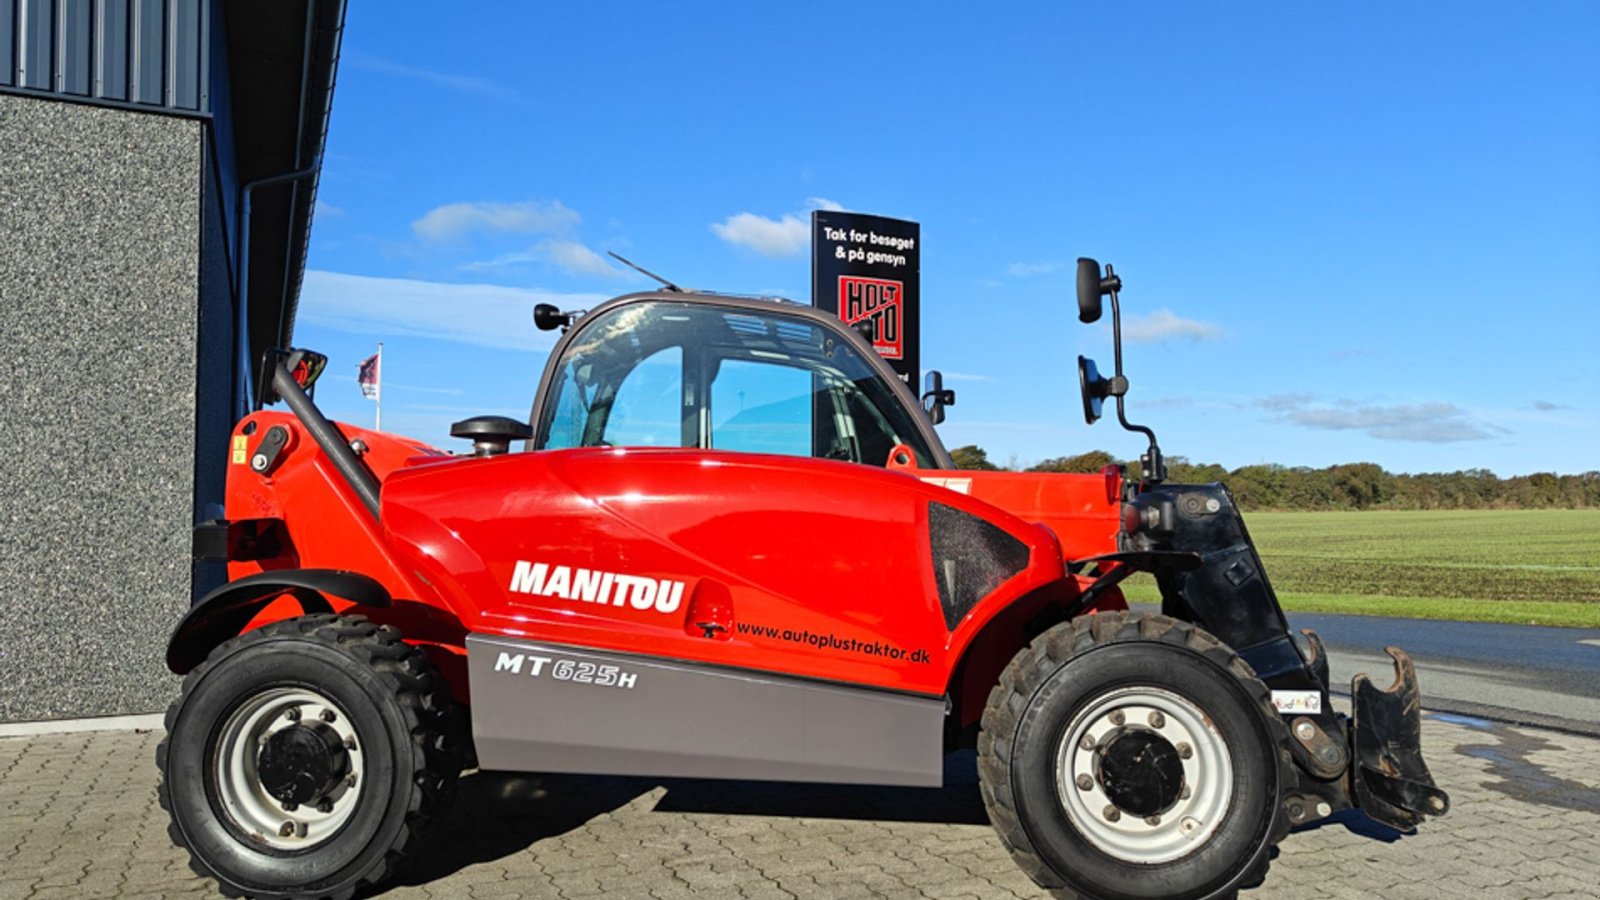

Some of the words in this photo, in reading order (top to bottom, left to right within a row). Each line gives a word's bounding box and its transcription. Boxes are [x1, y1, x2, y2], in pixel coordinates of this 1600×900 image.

[824, 227, 847, 241] Tak
[849, 229, 868, 243] for
[870, 231, 915, 251] besøget
[835, 245, 846, 259] &
[848, 247, 865, 263] på
[866, 251, 906, 267] gensyn
[847, 281, 897, 319] HOLT
[509, 560, 685, 613] MANITOU
[737, 622, 930, 664] www.autoplustraktor.dk
